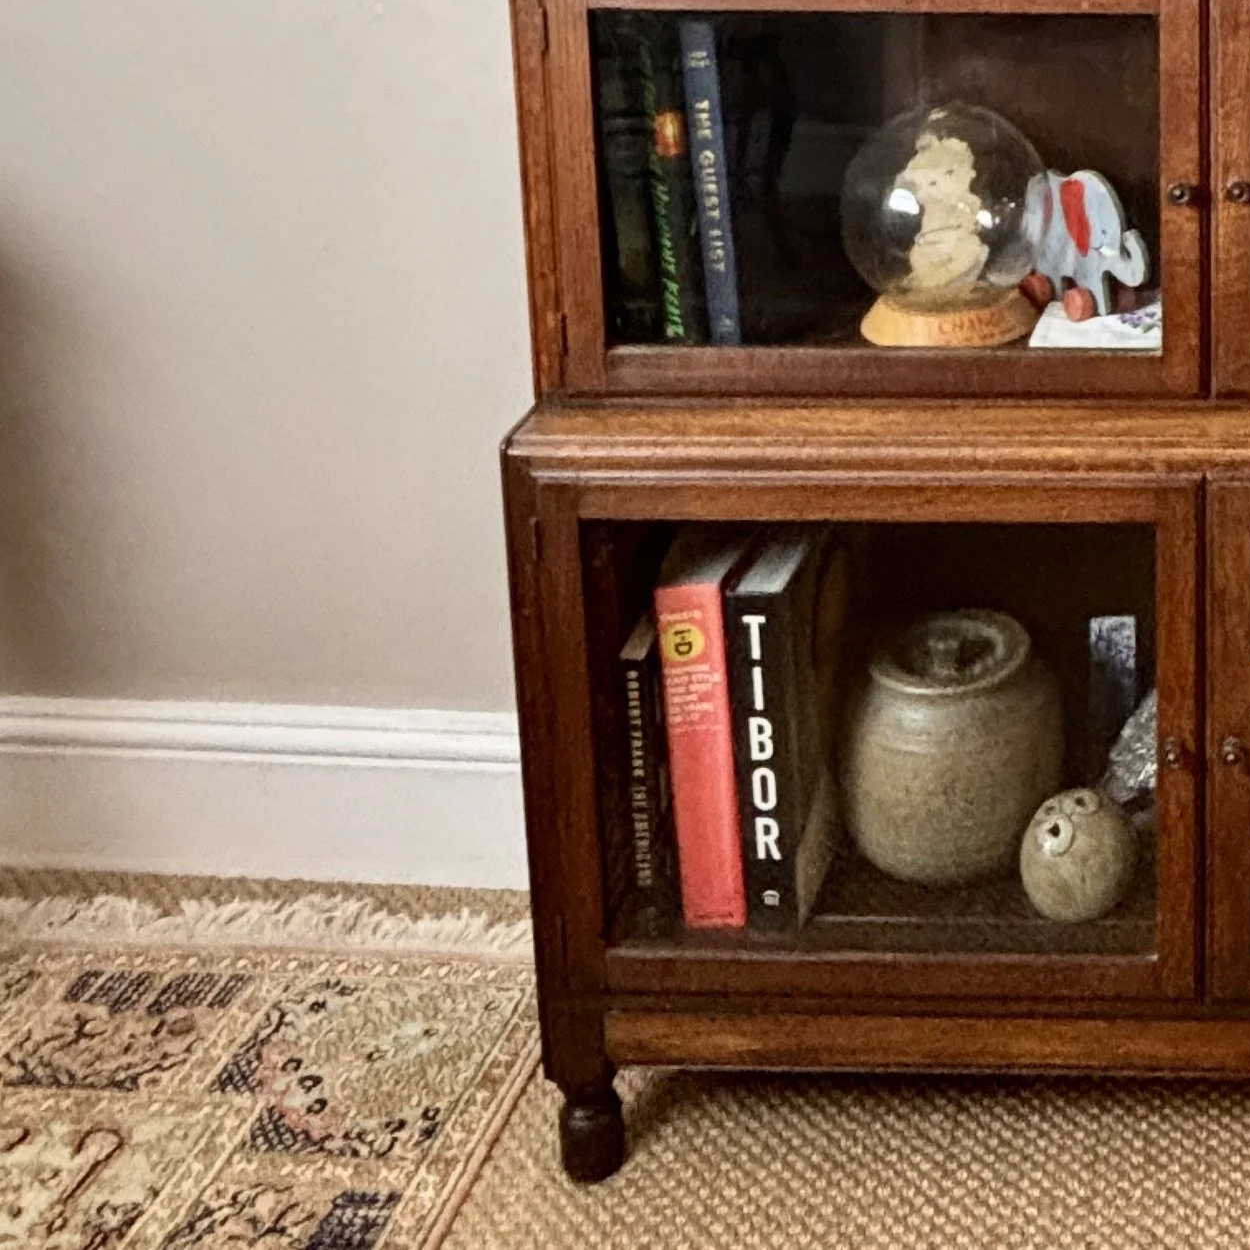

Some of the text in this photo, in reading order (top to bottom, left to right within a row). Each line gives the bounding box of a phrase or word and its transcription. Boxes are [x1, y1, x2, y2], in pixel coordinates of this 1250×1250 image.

[694, 98, 726, 274] THE GUEST LIST
[741, 614, 783, 862] TIBOR
